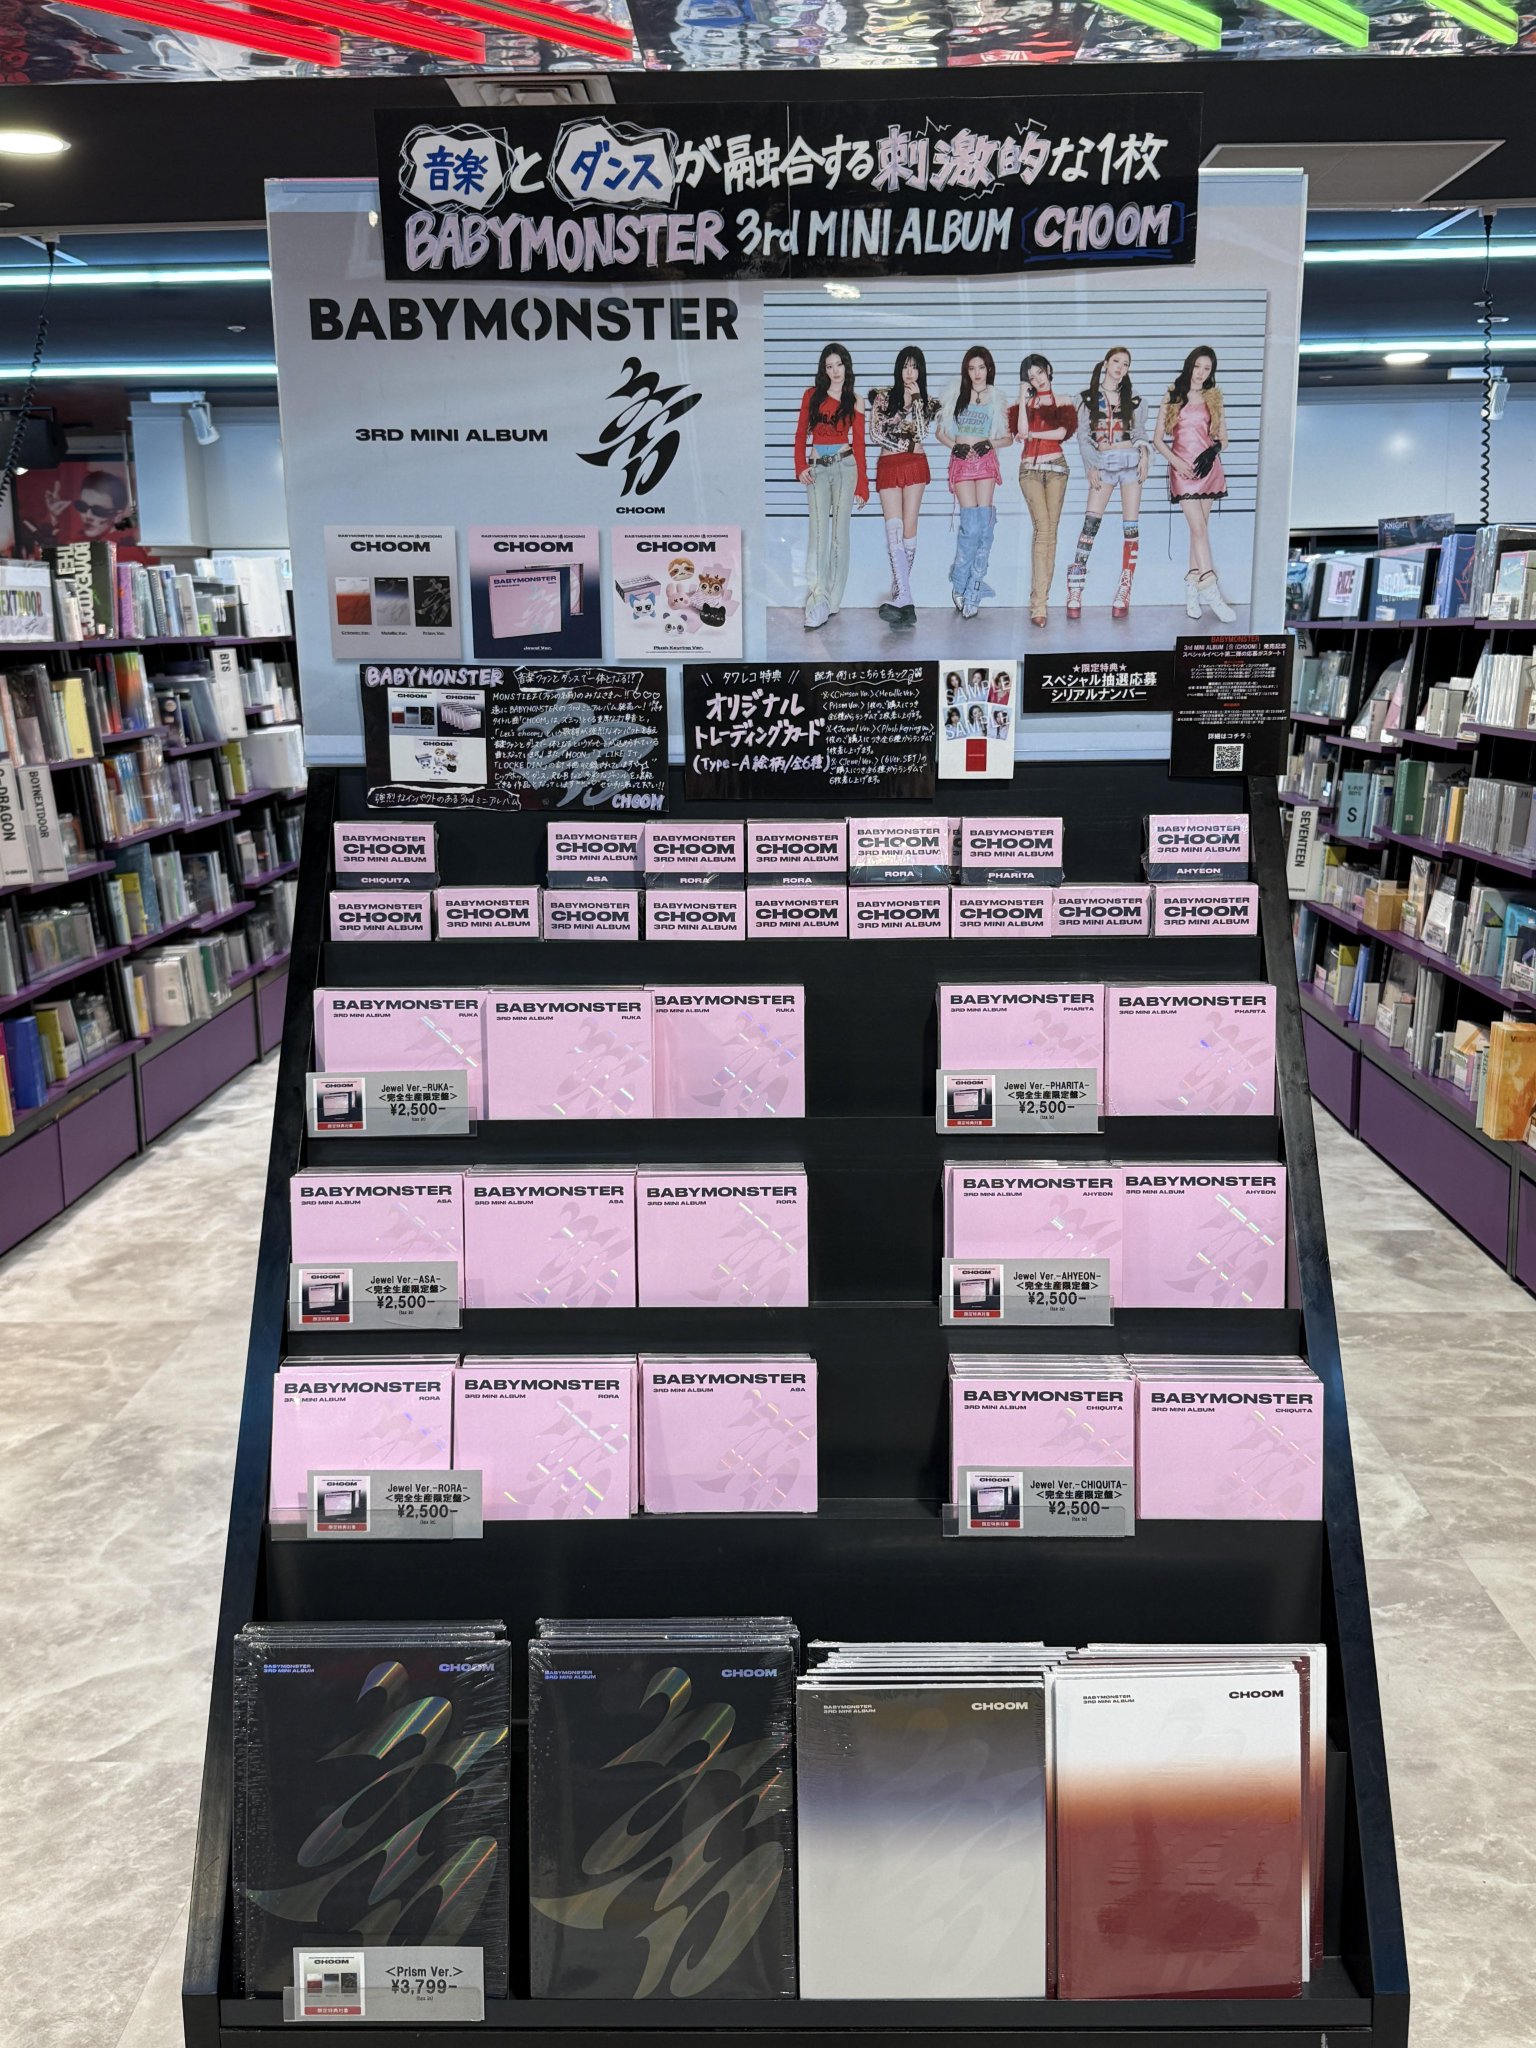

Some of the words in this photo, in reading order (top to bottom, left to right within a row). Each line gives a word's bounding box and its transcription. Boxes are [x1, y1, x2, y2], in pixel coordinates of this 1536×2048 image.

[405, 210, 730, 272] BABYMONSTER
[736, 207, 798, 257] 3rd
[807, 208, 893, 258] MINI
[894, 206, 1014, 255] ALBUM
[308, 296, 739, 342] BABYMONSTER
[355, 428, 404, 443] 3RD
[410, 428, 459, 443] MINI
[465, 428, 549, 443] ALBUM
[615, 506, 666, 515] CHOOM
[350, 541, 431, 553] CHOOM
[493, 541, 574, 553] CHOOM
[636, 541, 716, 553] CHOOM
[493, 575, 557, 585] BABYMONSTER
[218, 652, 231, 673] BTS
[1081, 663, 1119, 673] 限定特典
[365, 666, 505, 688] BABYMONSTER
[722, 670, 782, 685] タワレコ特典
[1041, 672, 1158, 688] スペシャル抽選応募
[945, 675, 1011, 706] SAMPLE
[1050, 687, 1147, 702] シリアルナンバー
[706, 688, 805, 722] オリジナル
[945, 709, 1011, 740] SAMPLE
[694, 717, 826, 750] トレーディングカード
[29, 770, 50, 839] BOYNEXTDOOR
[612, 793, 665, 811] CHOOM
[555, 833, 638, 841] BABYMONSTER
[857, 836, 940, 848] CHOOM
[1157, 834, 1240, 845] CHOOM
[1294, 810, 1312, 868] SEVENTEEN
[343, 843, 426, 855] CHOOM
[555, 842, 637, 853] CHOOM
[653, 843, 735, 855] CHOOM
[756, 843, 838, 855] CHOOM
[970, 838, 1053, 849] CHOOM
[653, 902, 737, 910] BABYMONSTER
[857, 899, 941, 907] BABYMONSTER
[1058, 897, 1143, 905] BABYMONSTER
[1164, 897, 1250, 905] BABYMONSTER
[446, 908, 529, 919] CHOOM
[551, 911, 629, 922] CHOOM
[654, 911, 736, 923] CHOOM
[755, 908, 838, 919] CHOOM
[857, 908, 940, 920] CHOOM
[960, 908, 1043, 919] CHOOM
[1058, 907, 1141, 917] CHOOM
[1164, 905, 1249, 917] CHOOM
[338, 912, 422, 923] CHOOM
[332, 999, 479, 1010] BABYMONSTER
[654, 995, 796, 1006] BABYMONSTER
[950, 993, 1095, 1005] BABYMONSTER
[1118, 995, 1267, 1007] BABYMONSTER
[495, 1003, 642, 1013] BABYMONSTER
[381, 1084, 404, 1093] Jewel
[406, 1083, 454, 1092] Ver.-RUKA-
[1003, 1082, 1027, 1091] Jewel
[1029, 1081, 1090, 1090] Ver.-PHARITA-
[390, 1103, 447, 1117] ¥2,500-
[1018, 1101, 1075, 1114] ¥2,500-
[963, 1178, 1114, 1189] BABYMONSTER
[1125, 1175, 1277, 1187] BABYMONSTER
[300, 1185, 452, 1197] BABYMONSTER
[474, 1186, 624, 1197] BABYMONSTER
[646, 1186, 798, 1198] BABYMONSTER
[370, 1275, 395, 1284] Jewel
[398, 1274, 441, 1284] Ver.-ASA-
[1013, 1271, 1037, 1281] Jewel
[1039, 1271, 1102, 1280] Ver.-AHYEON-
[377, 1295, 436, 1309] ¥2,500-
[1027, 1291, 1087, 1306] ¥2,500-
[464, 1379, 620, 1390] BABYMONSTER
[652, 1373, 807, 1385] BABYMONSTER
[284, 1381, 442, 1394] BABYMONSTER
[963, 1390, 1124, 1402] BABYMONSTER
[1150, 1392, 1314, 1405] BABYMONSTER
[387, 1484, 412, 1493] Jewel
[415, 1483, 468, 1493] Ver.-RORA-
[1030, 1480, 1055, 1490] Jewel
[1058, 1479, 1128, 1489] Ver.-CHIQUITA-
[397, 1504, 459, 1519] ¥2,500-
[1048, 1501, 1110, 1516] ¥2,500-
[438, 1663, 496, 1672] CHOOM
[721, 1668, 778, 1678] CHOOM
[1228, 1689, 1285, 1699] CHOOM
[971, 1702, 1029, 1711] CHOOM
[385, 1965, 427, 1977] <Prism
[430, 1965, 464, 1978] Ver.>
[391, 1978, 458, 1995] ¥3,799-
